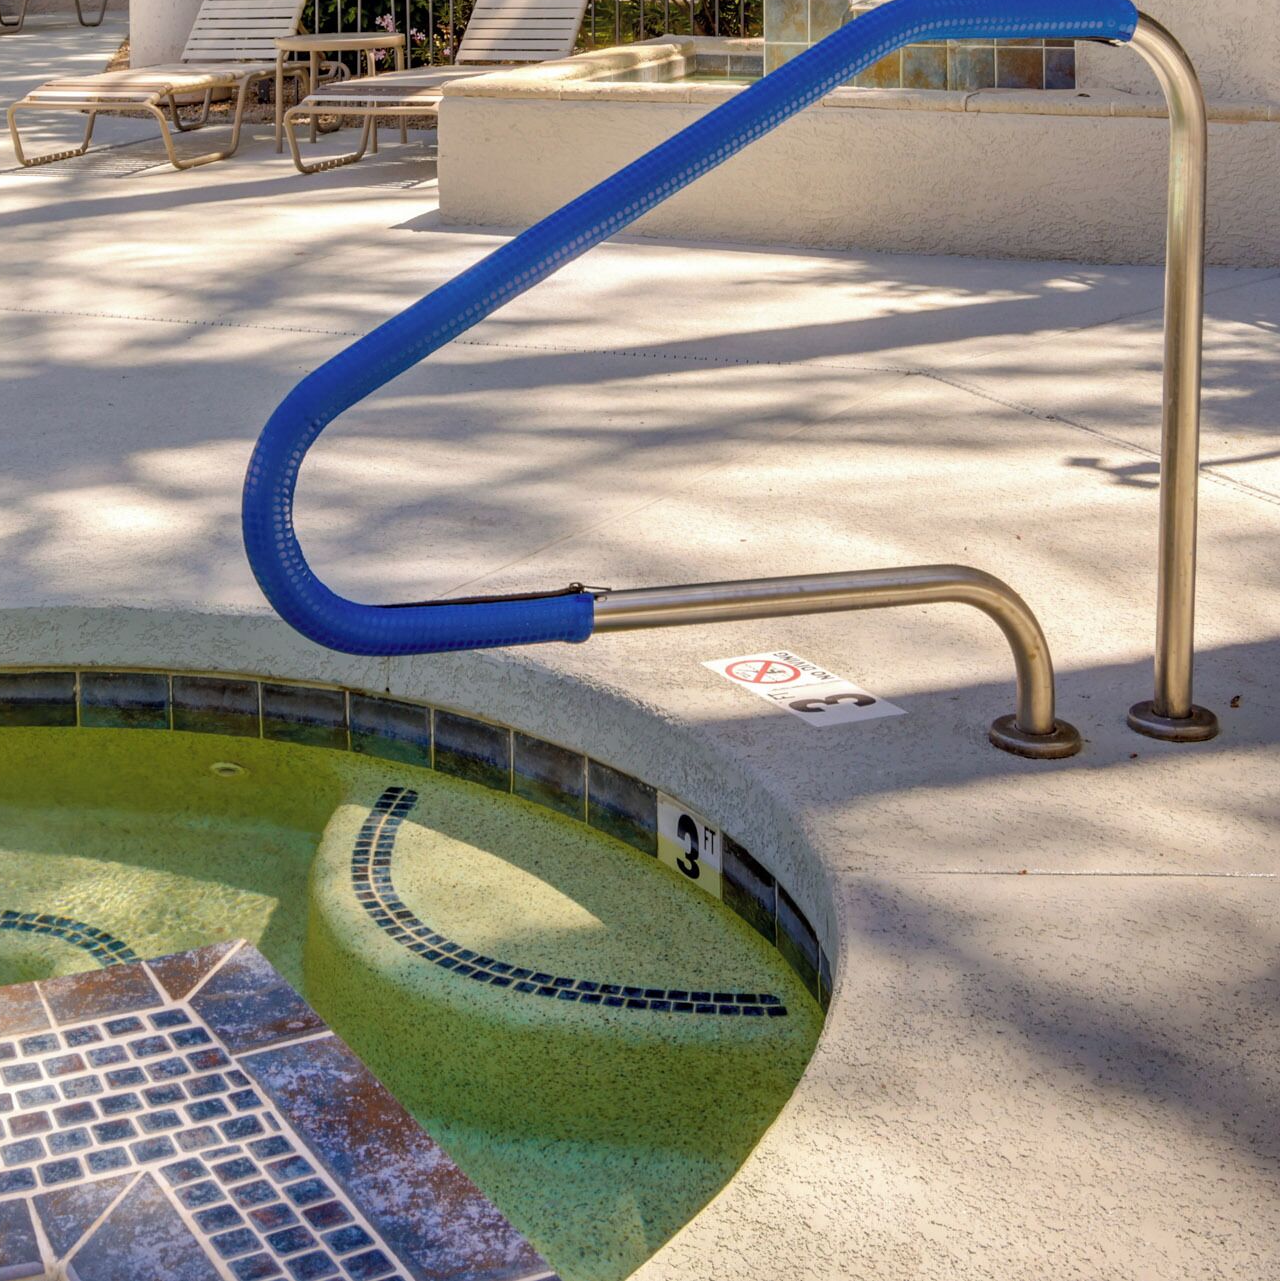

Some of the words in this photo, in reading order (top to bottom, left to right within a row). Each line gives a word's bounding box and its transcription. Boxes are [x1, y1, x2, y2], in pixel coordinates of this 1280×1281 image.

[773, 651, 817, 673] DIVING
[810, 670, 835, 680] NO
[788, 693, 876, 713] 3
[677, 814, 700, 879] 3
[704, 825, 716, 855] FT
